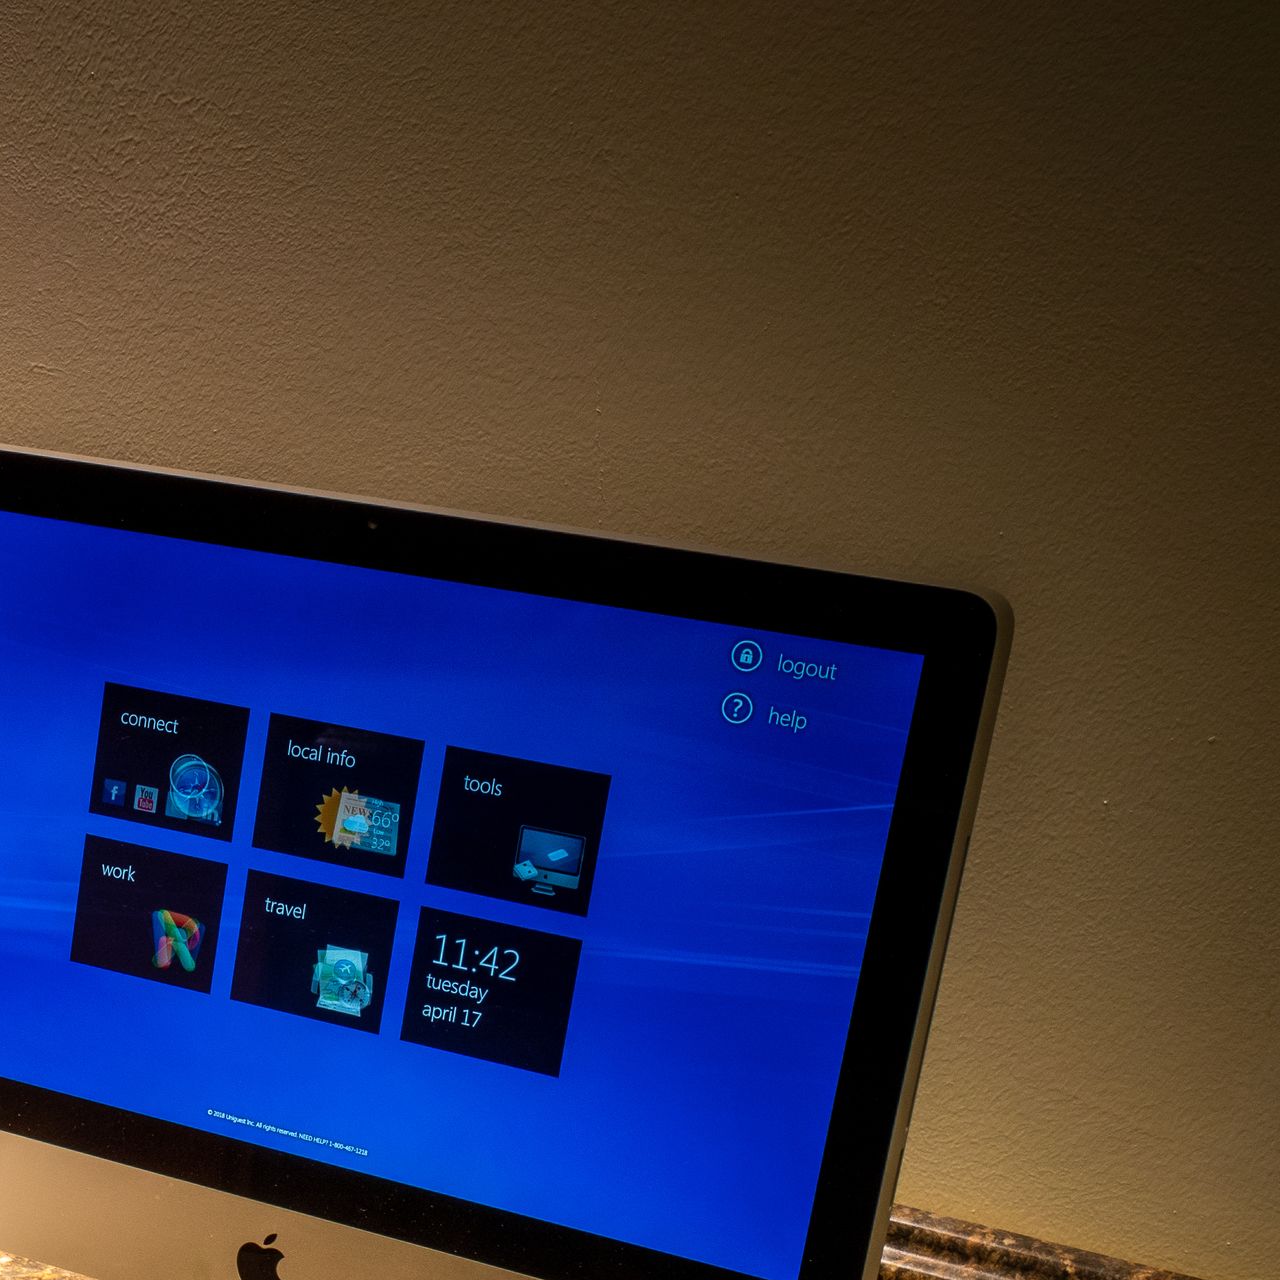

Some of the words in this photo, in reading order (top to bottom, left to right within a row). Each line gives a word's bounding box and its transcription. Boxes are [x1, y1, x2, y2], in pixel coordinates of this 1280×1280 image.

[777, 653, 838, 681] logout
[120, 710, 179, 734] connect
[768, 706, 807, 733] help
[287, 740, 322, 764] local
[326, 745, 357, 769] info
[463, 774, 503, 797] tools
[101, 862, 135, 883] work
[264, 898, 307, 921] travel
[432, 934, 521, 982] 11:42
[426, 973, 489, 1004] tuesday
[422, 1003, 457, 1028] april
[460, 1008, 482, 1029] 17
[263, 1123, 277, 1133] rights
[299, 1133, 313, 1142] NEED
